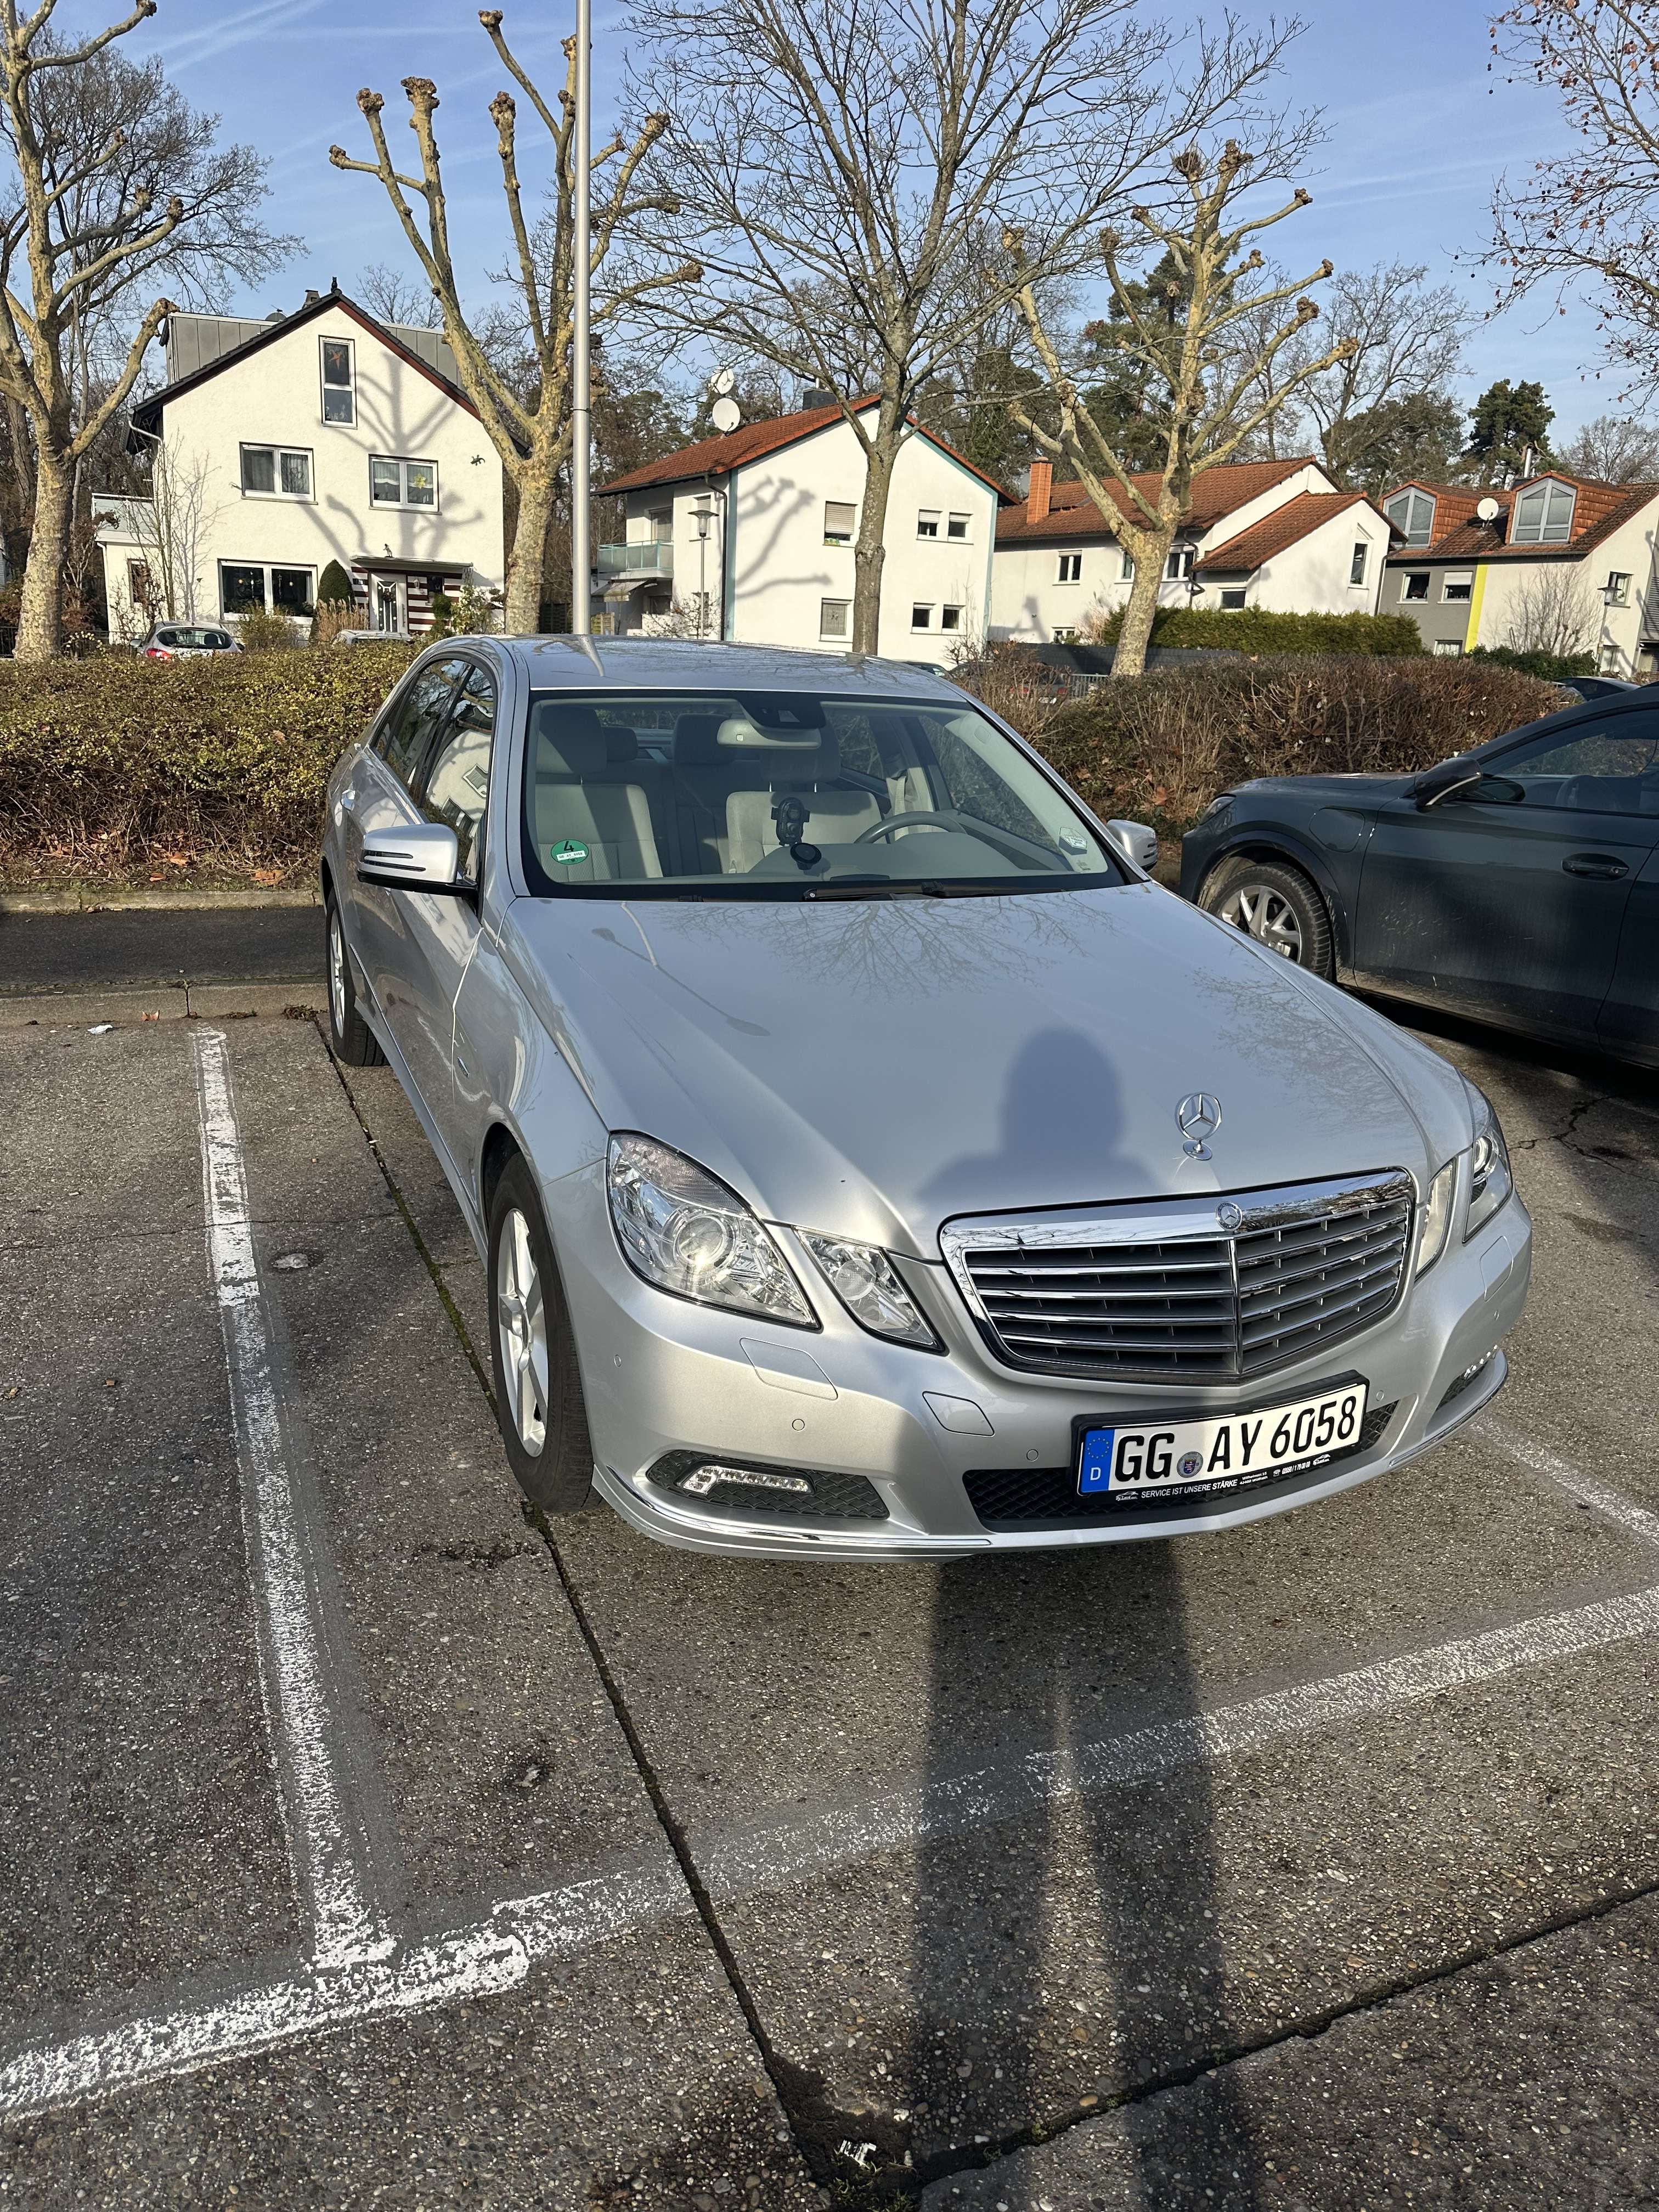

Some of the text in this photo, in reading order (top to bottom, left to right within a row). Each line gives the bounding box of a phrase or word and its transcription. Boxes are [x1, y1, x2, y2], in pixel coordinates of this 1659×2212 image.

[564, 841, 574, 851] 4
[1115, 1396, 1356, 1482] GG AY 6058
[1091, 1467, 1101, 1481] D
[1141, 1489, 1171, 1498] SERVICE
[1184, 1483, 1211, 1494] UNSERE
[1212, 1480, 1238, 1490] STÄRKE
